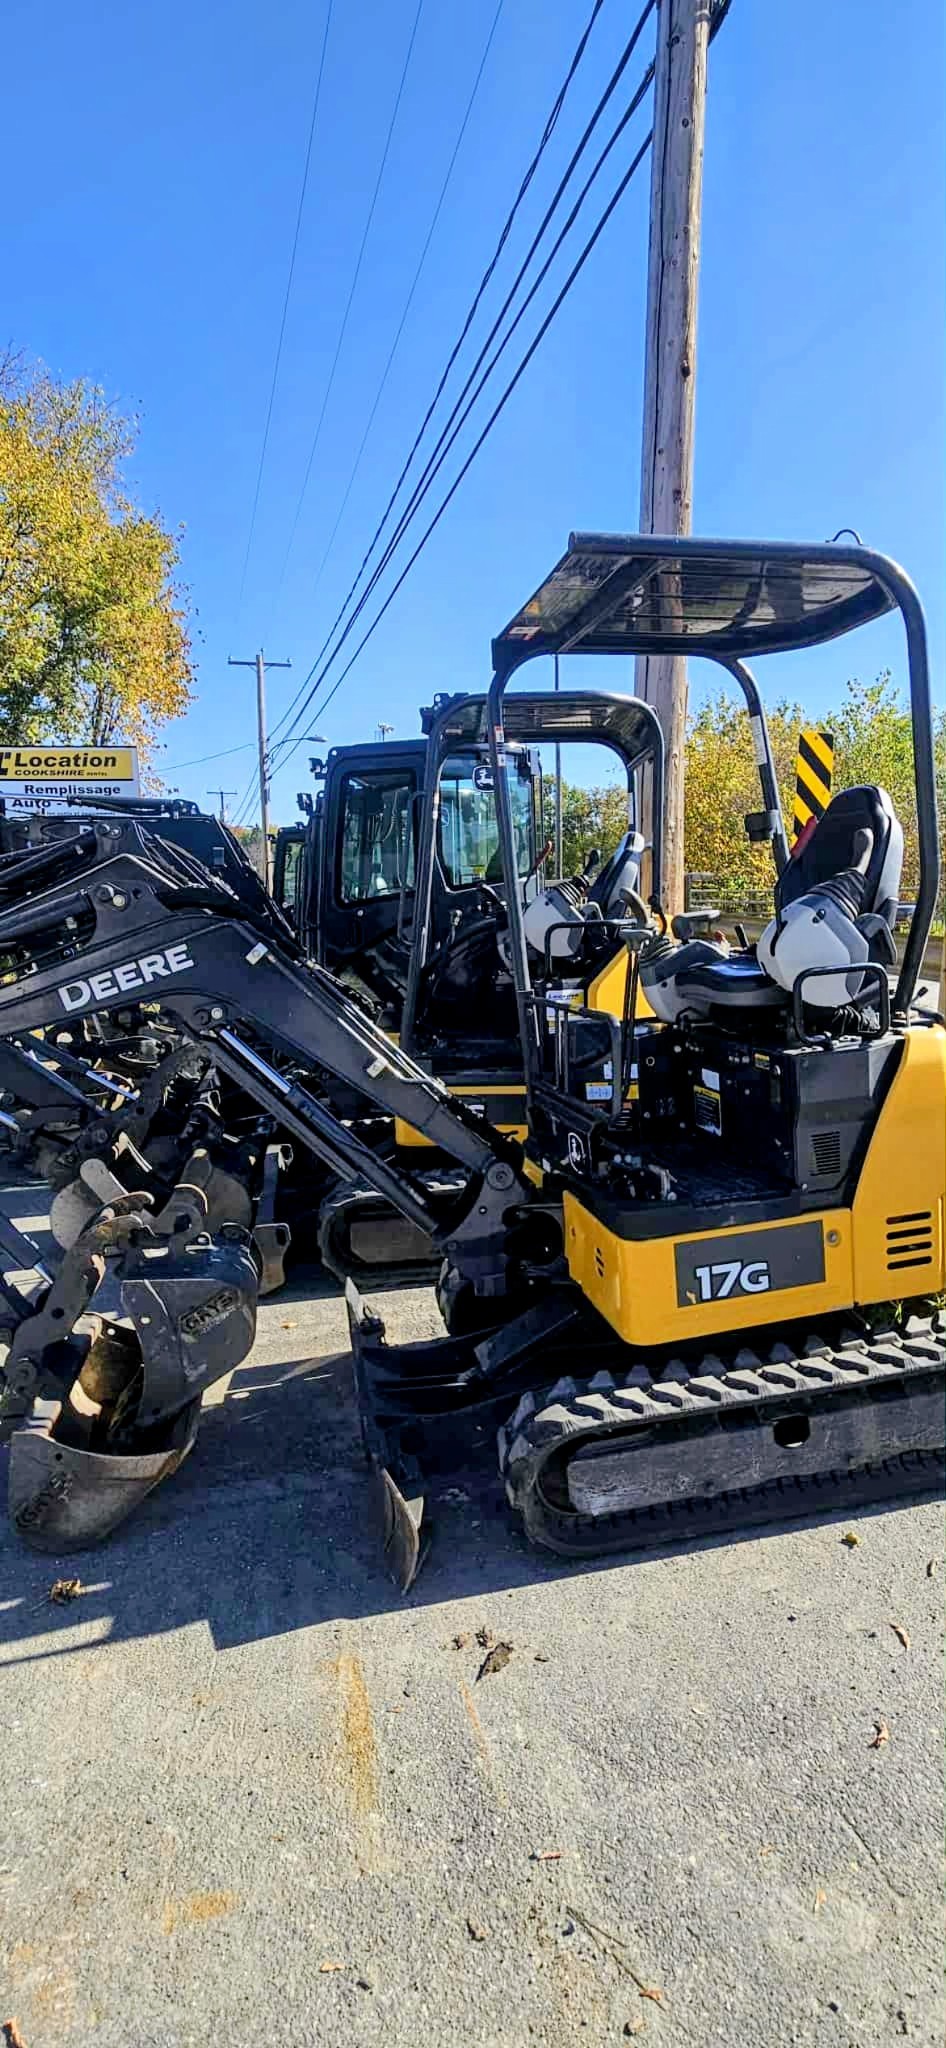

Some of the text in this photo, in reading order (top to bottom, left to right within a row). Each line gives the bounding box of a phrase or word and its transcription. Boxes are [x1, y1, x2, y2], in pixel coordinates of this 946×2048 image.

[15, 753, 117, 768] Location
[24, 785, 121, 796] Remplissage
[58, 943, 194, 1011] DEERE
[695, 1260, 770, 1301] 17G
